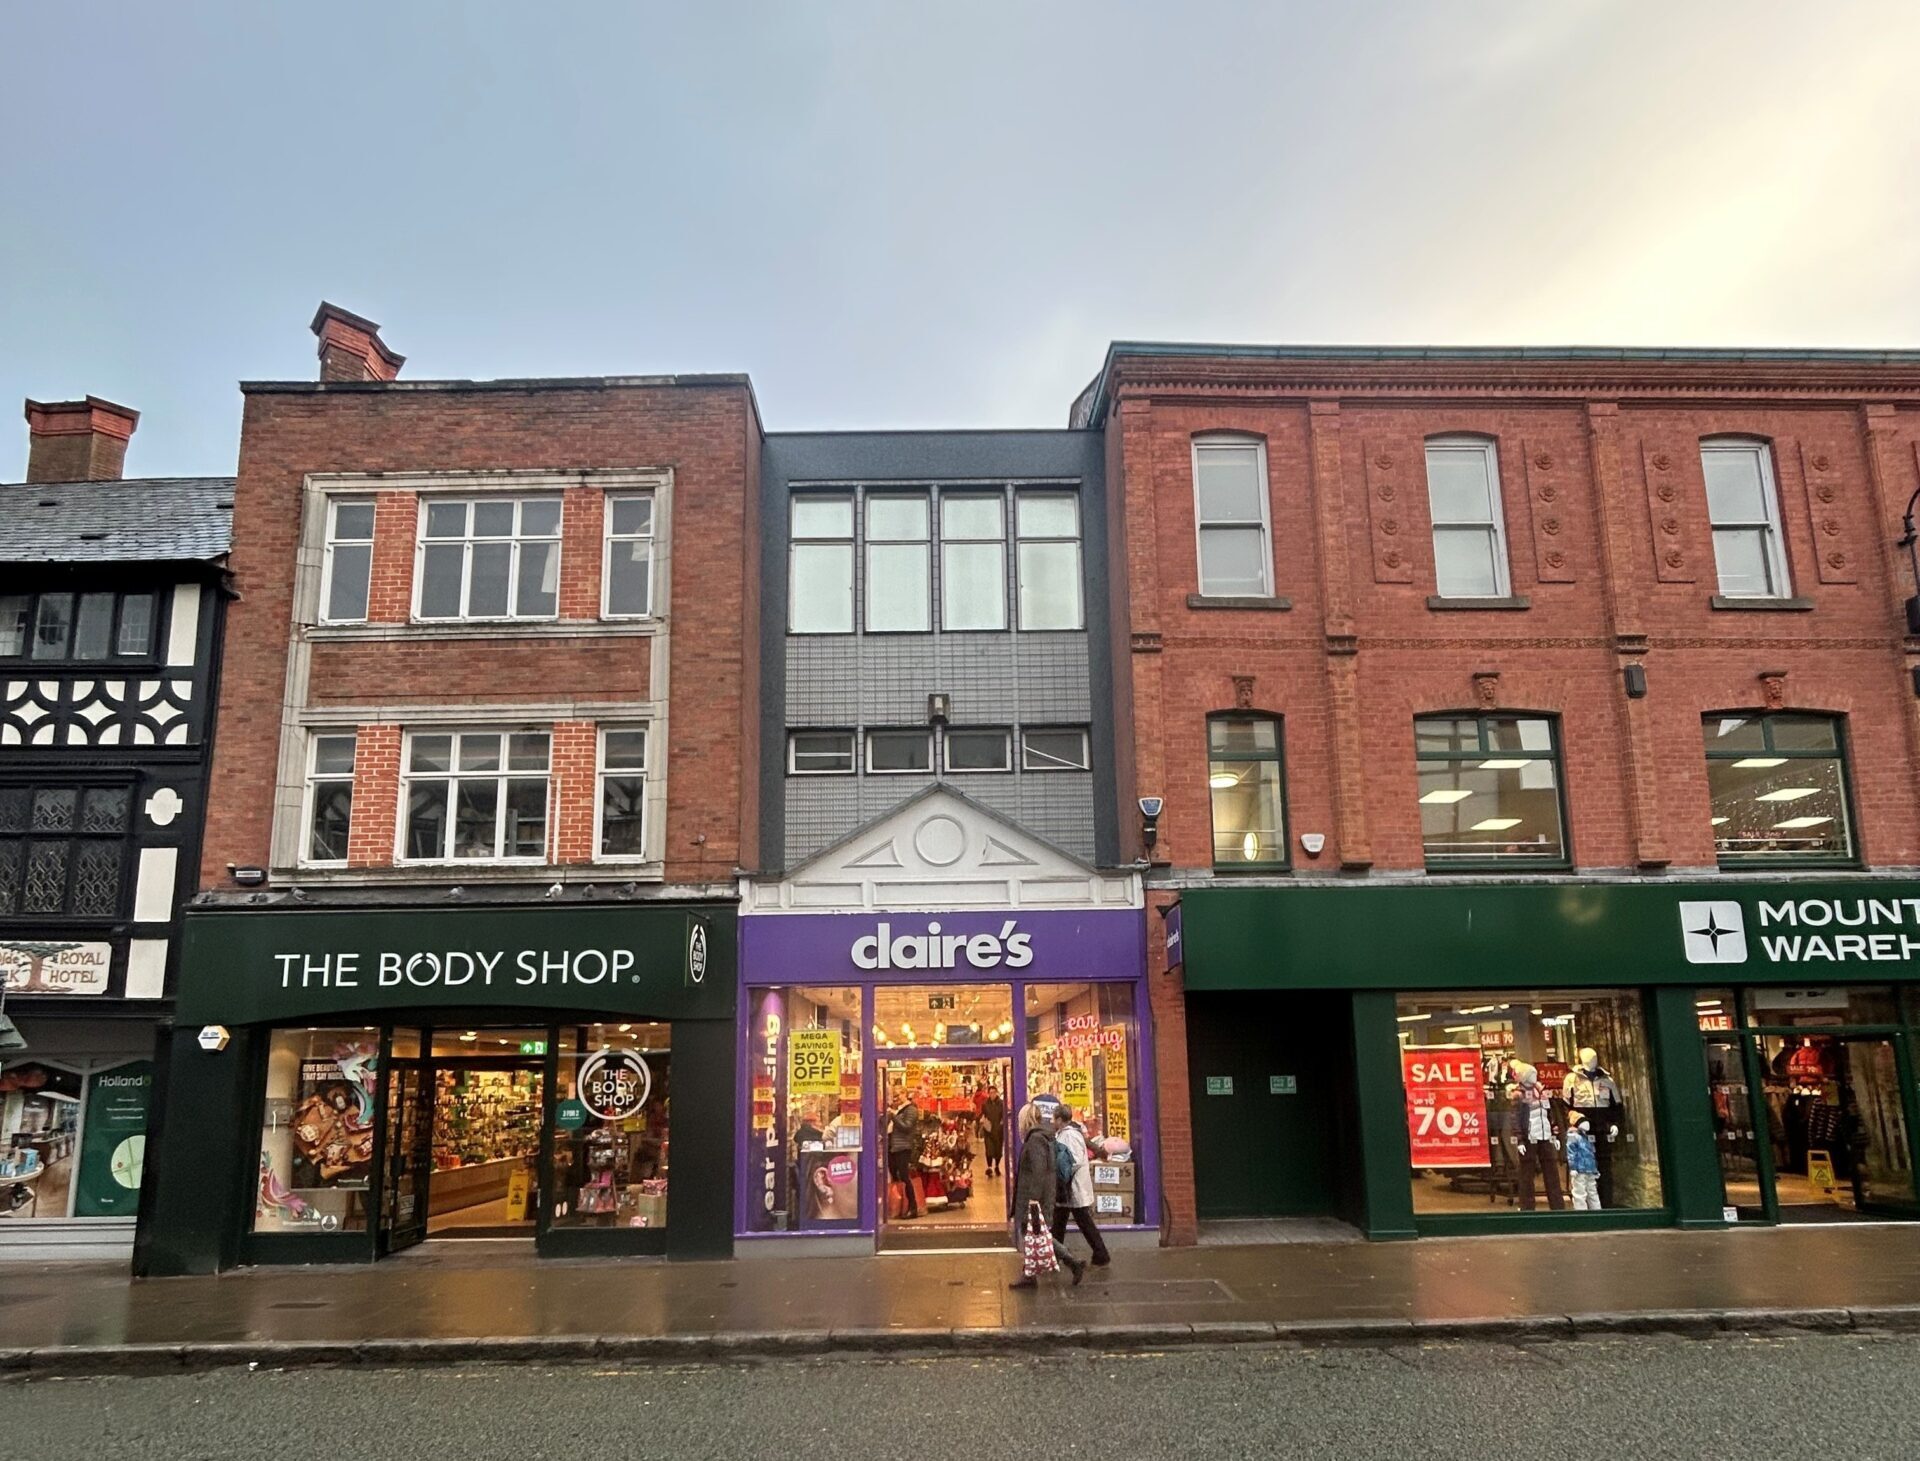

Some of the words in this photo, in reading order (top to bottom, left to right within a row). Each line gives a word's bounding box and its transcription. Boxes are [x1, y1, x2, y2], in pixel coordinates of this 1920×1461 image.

[1758, 899, 1920, 926] MOUNT
[851, 921, 1033, 969] claire's
[0, 952, 20, 966] lde
[61, 952, 105, 966] ROYAL
[274, 953, 360, 988] THE
[378, 951, 504, 987] BODY
[49, 970, 99, 984] HOTEL
[1067, 1015, 1098, 1030] ear
[1699, 1016, 1729, 1030] ALE
[1056, 1029, 1124, 1058] piercing
[1481, 1033, 1500, 1045] SALE
[794, 1042, 834, 1050] SAVINGS
[794, 1052, 834, 1065] 50%
[794, 1066, 832, 1079] OFF
[1107, 1061, 1124, 1073] OFF
[1411, 1063, 1476, 1083] SALE
[99, 1075, 143, 1087] Holland
[602, 1069, 629, 1080] THE
[1064, 1071, 1087, 1081] 50%
[1539, 1070, 1565, 1079] SALE
[592, 1081, 637, 1094] BODY
[932, 1078, 949, 1086] OFF
[1064, 1083, 1086, 1092] OFF
[594, 1095, 634, 1107] SHOP
[1109, 1112, 1126, 1126] 50%
[764, 1157, 776, 1211] ear
